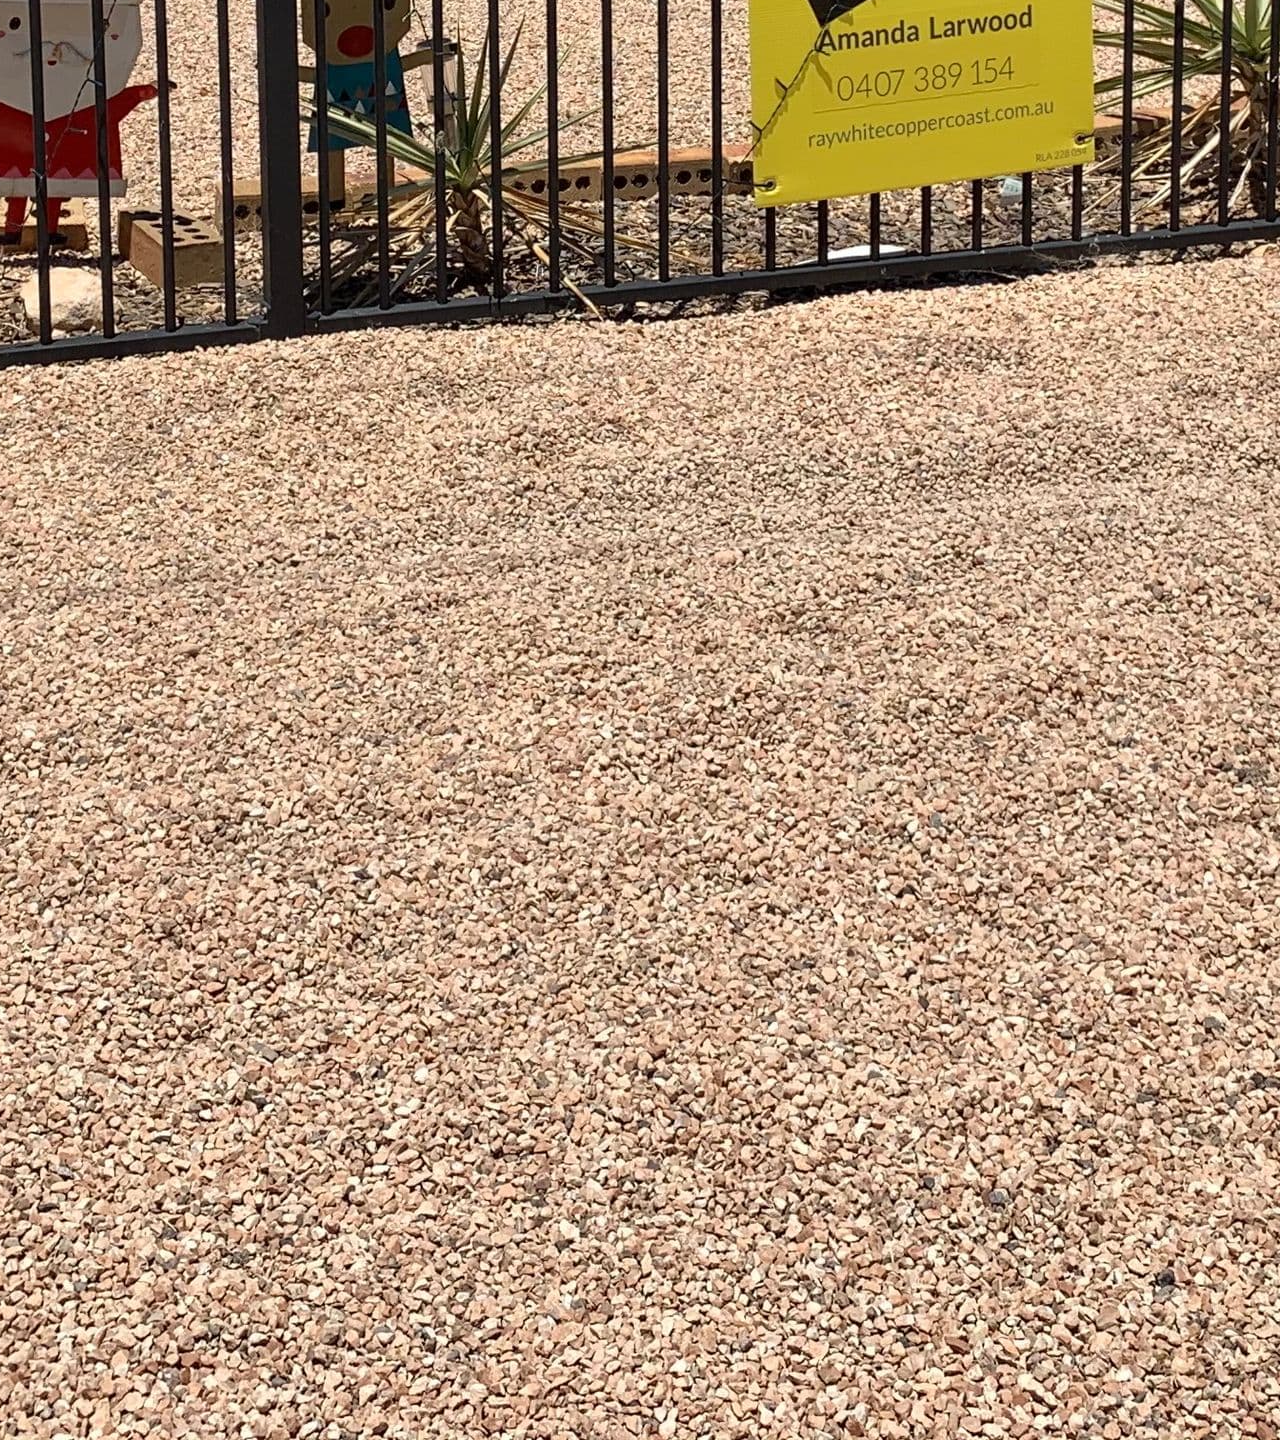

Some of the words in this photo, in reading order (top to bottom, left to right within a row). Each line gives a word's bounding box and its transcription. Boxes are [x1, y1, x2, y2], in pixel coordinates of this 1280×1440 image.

[819, 19, 920, 52] Amanda
[929, 4, 1033, 40] Larwood
[837, 68, 906, 101] 0407
[914, 62, 963, 93] 389
[970, 56, 1015, 86] 154
[808, 101, 1054, 149] raywhitecoppercoast.com.au
